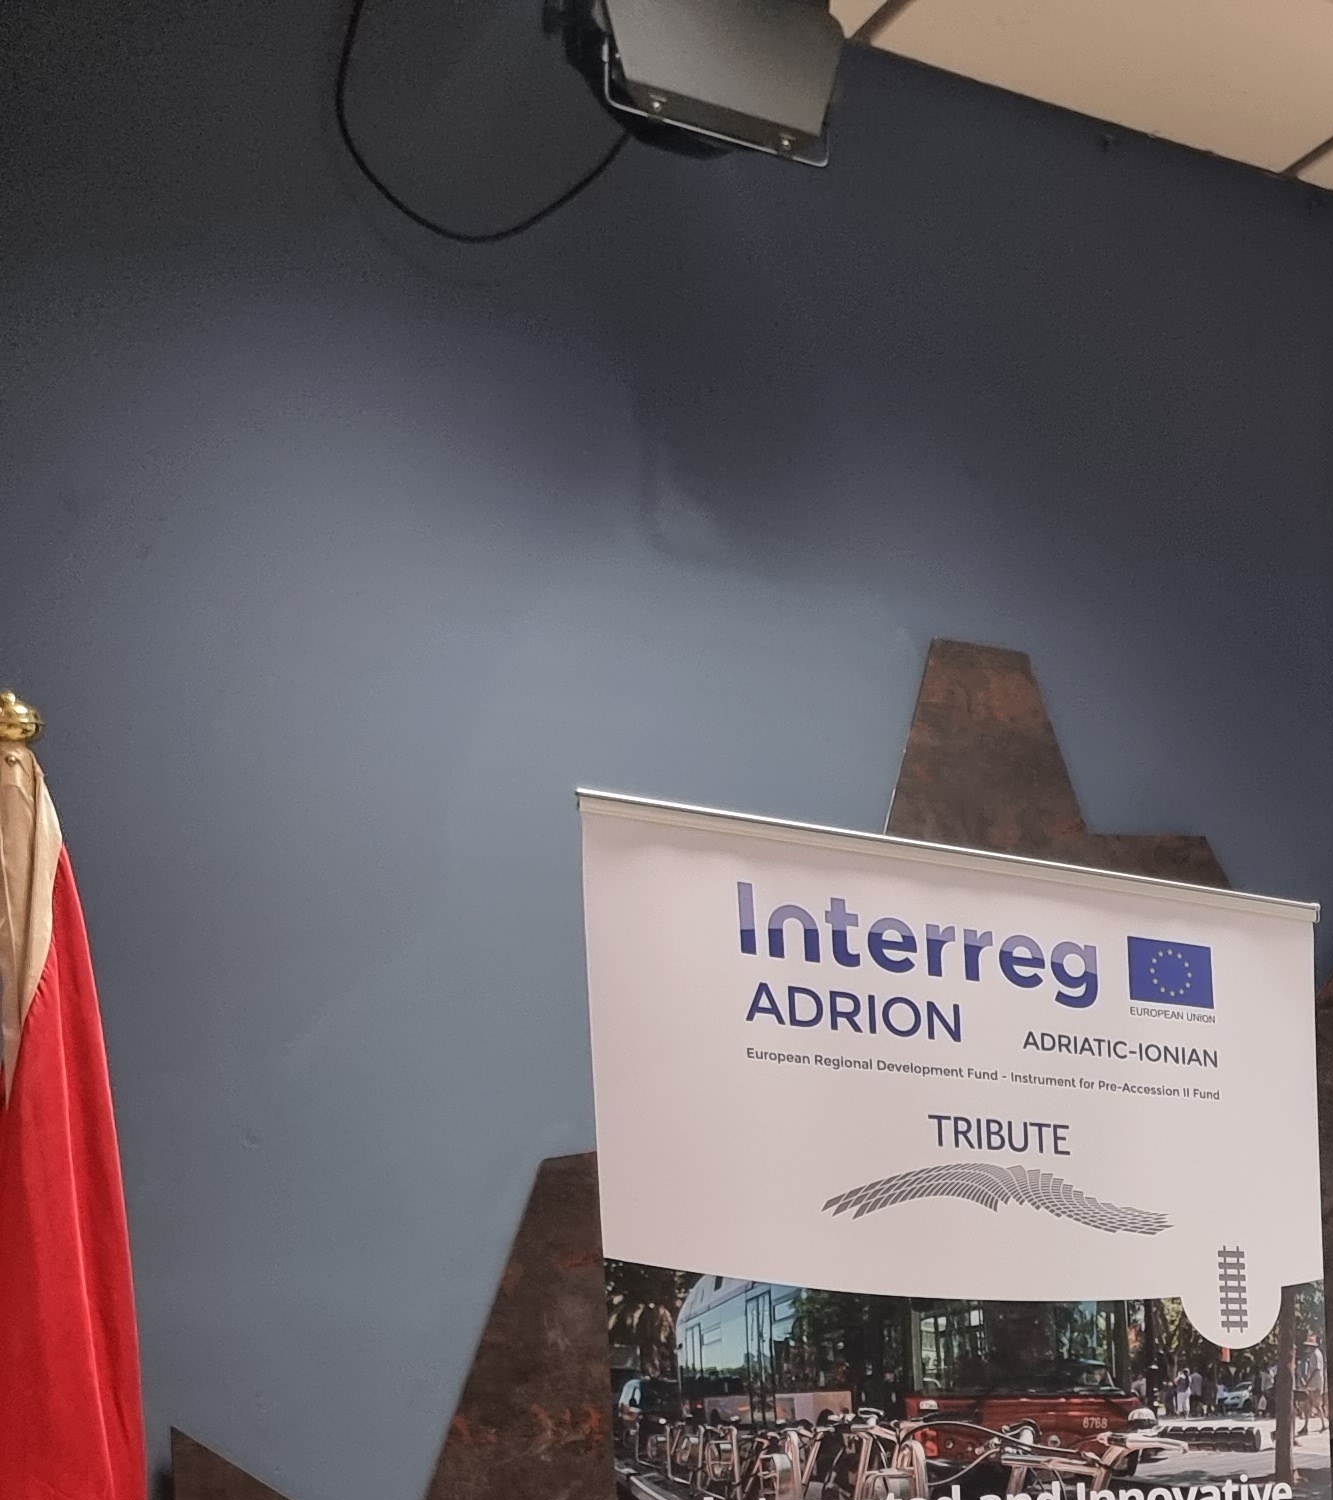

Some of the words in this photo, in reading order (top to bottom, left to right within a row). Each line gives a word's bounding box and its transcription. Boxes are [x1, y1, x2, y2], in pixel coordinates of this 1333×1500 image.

[737, 882, 1098, 1008] Interreg
[746, 982, 961, 1042] ADRION
[1130, 1007, 1183, 1019] EUROPEAN
[1023, 1031, 1217, 1068] ADRIATIC-IONIAN
[747, 1048, 810, 1064] European
[815, 1055, 872, 1070] Regional
[877, 1060, 964, 1078] Development
[968, 1068, 998, 1080] Fund
[1011, 1072, 1076, 1088] Instrument
[1079, 1078, 1094, 1089] for
[1099, 1080, 1179, 1096] Pre-Accession
[1183, 1088, 1189, 1097] II
[1193, 1088, 1219, 1100] Fund
[928, 1115, 1070, 1155] TRIBUTE
